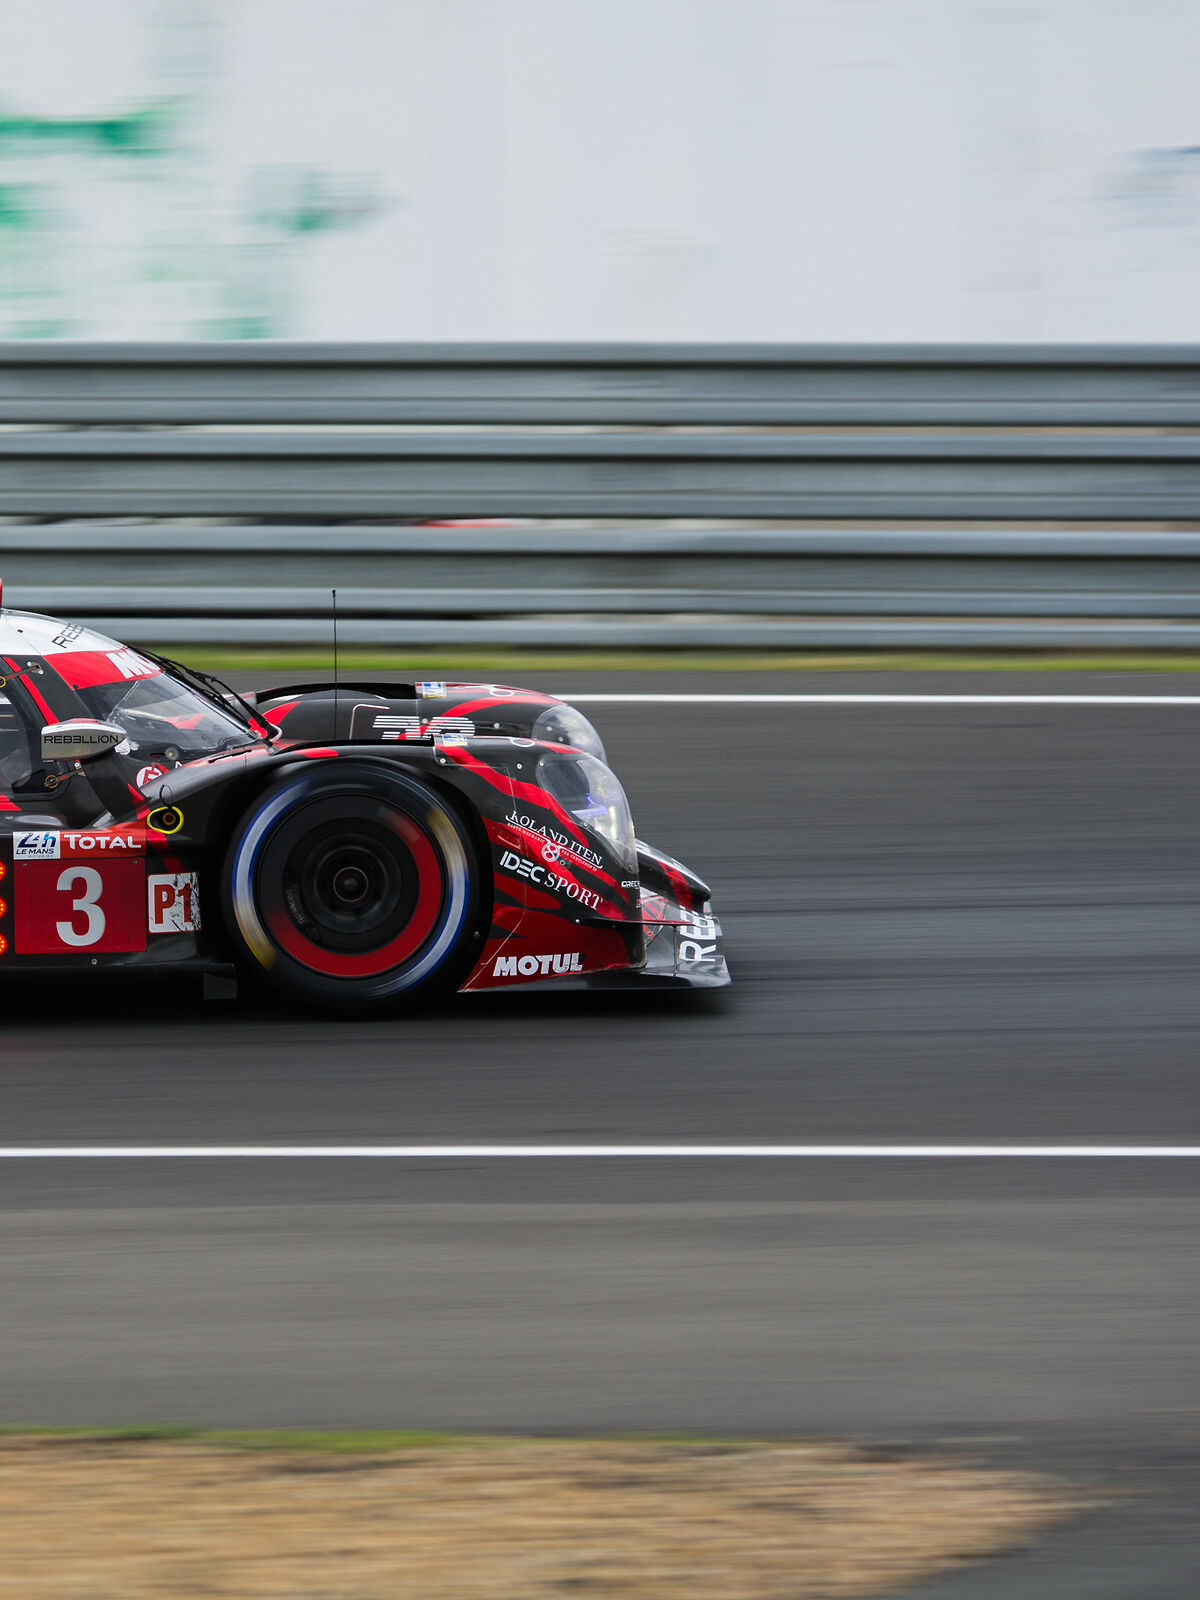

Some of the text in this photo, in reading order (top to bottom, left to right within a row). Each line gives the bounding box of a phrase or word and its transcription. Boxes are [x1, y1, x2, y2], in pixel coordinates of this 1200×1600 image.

[63, 833, 142, 850] TOTAL
[499, 851, 604, 911] IDEC SPORT
[56, 865, 107, 947] 3
[154, 882, 193, 925] P1
[492, 952, 584, 977] MOTUL
